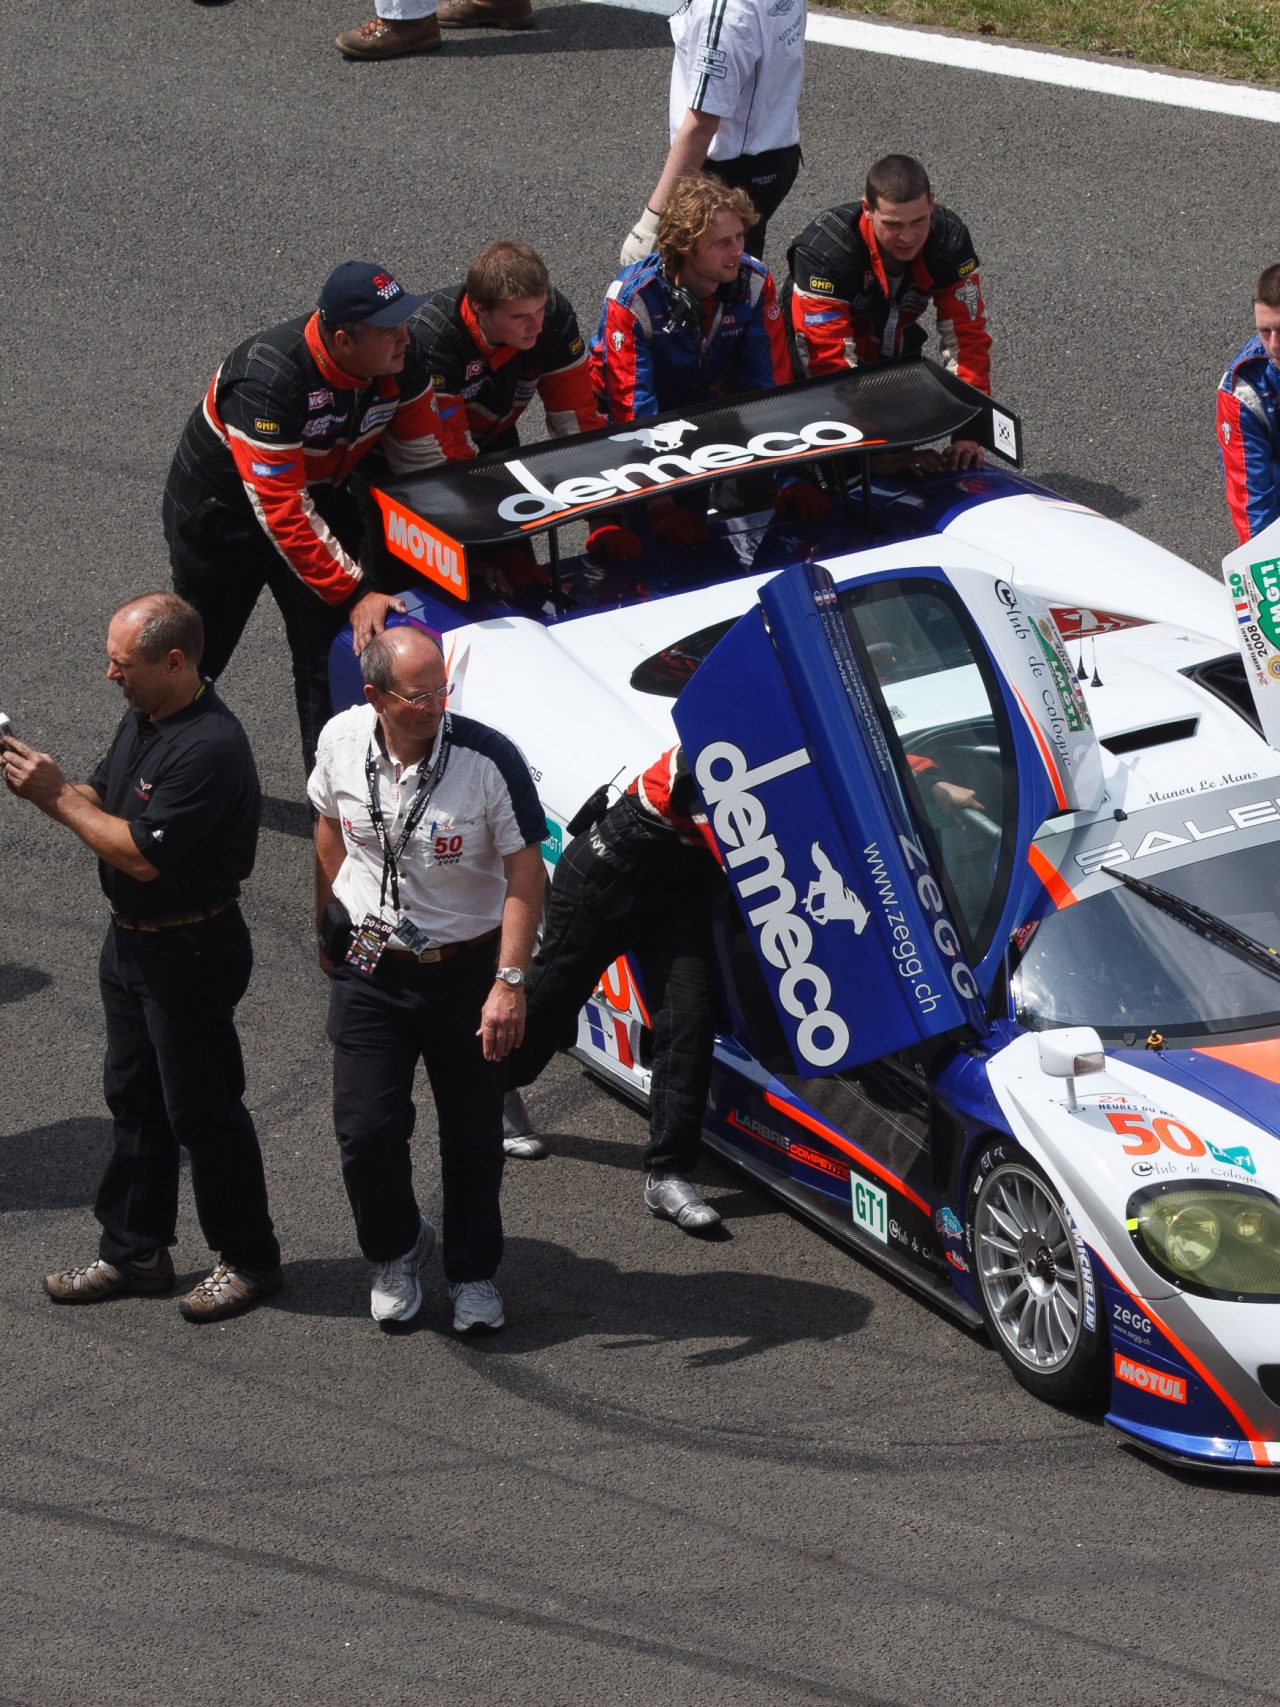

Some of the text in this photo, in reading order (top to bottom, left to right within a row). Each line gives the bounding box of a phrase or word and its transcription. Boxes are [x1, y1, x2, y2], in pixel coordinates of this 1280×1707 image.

[811, 280, 832, 291] OMP
[959, 261, 976, 275] OMP
[256, 421, 278, 432] OMP
[497, 420, 864, 523] demeco
[387, 510, 463, 588] MOTUL
[1229, 573, 1245, 598] 50
[1247, 625, 1268, 658] 2008
[1028, 655, 1046, 678] de
[1042, 690, 1071, 768] Cologne
[1146, 770, 1259, 805] Manou Le Mans
[433, 835, 463, 855] 50
[695, 741, 850, 1067] demeco
[863, 842, 942, 1014] www.zegg.ch
[1098, 1095, 1128, 1104] 24
[1142, 1106, 1156, 1114] DU
[733, 1109, 791, 1151] LARBRE
[1104, 1113, 1207, 1158] 50
[1186, 1162, 1200, 1174] de
[855, 1181, 885, 1234] GT1
[1020, 1266, 1037, 1299] RACING
[1073, 1228, 1096, 1332] MICHELIN
[1119, 1360, 1184, 1400] MOTUL
